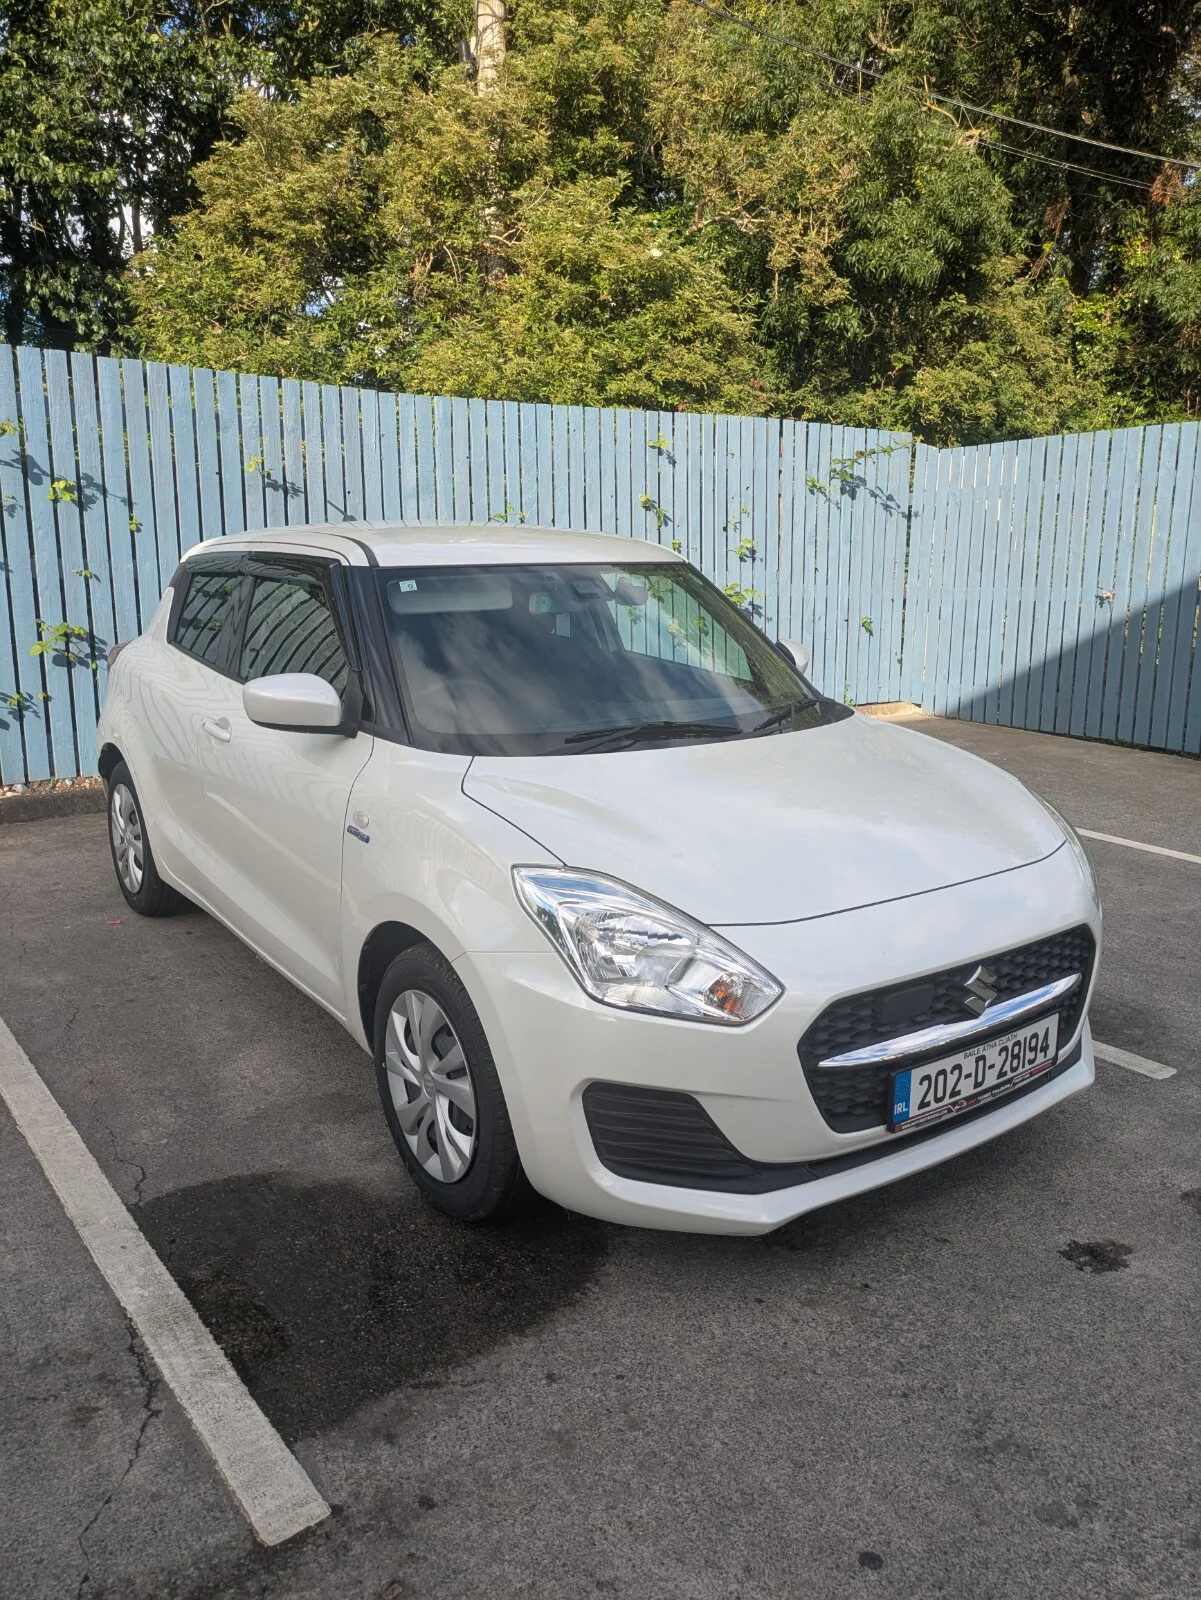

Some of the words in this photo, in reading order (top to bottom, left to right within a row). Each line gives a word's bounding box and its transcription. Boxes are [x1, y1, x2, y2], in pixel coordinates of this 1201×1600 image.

[963, 1047, 981, 1060] BAILE
[998, 1033, 1018, 1047] CLIATH
[917, 1026, 1050, 1111] 202-D-28194
[894, 1101, 909, 1116] IRL
